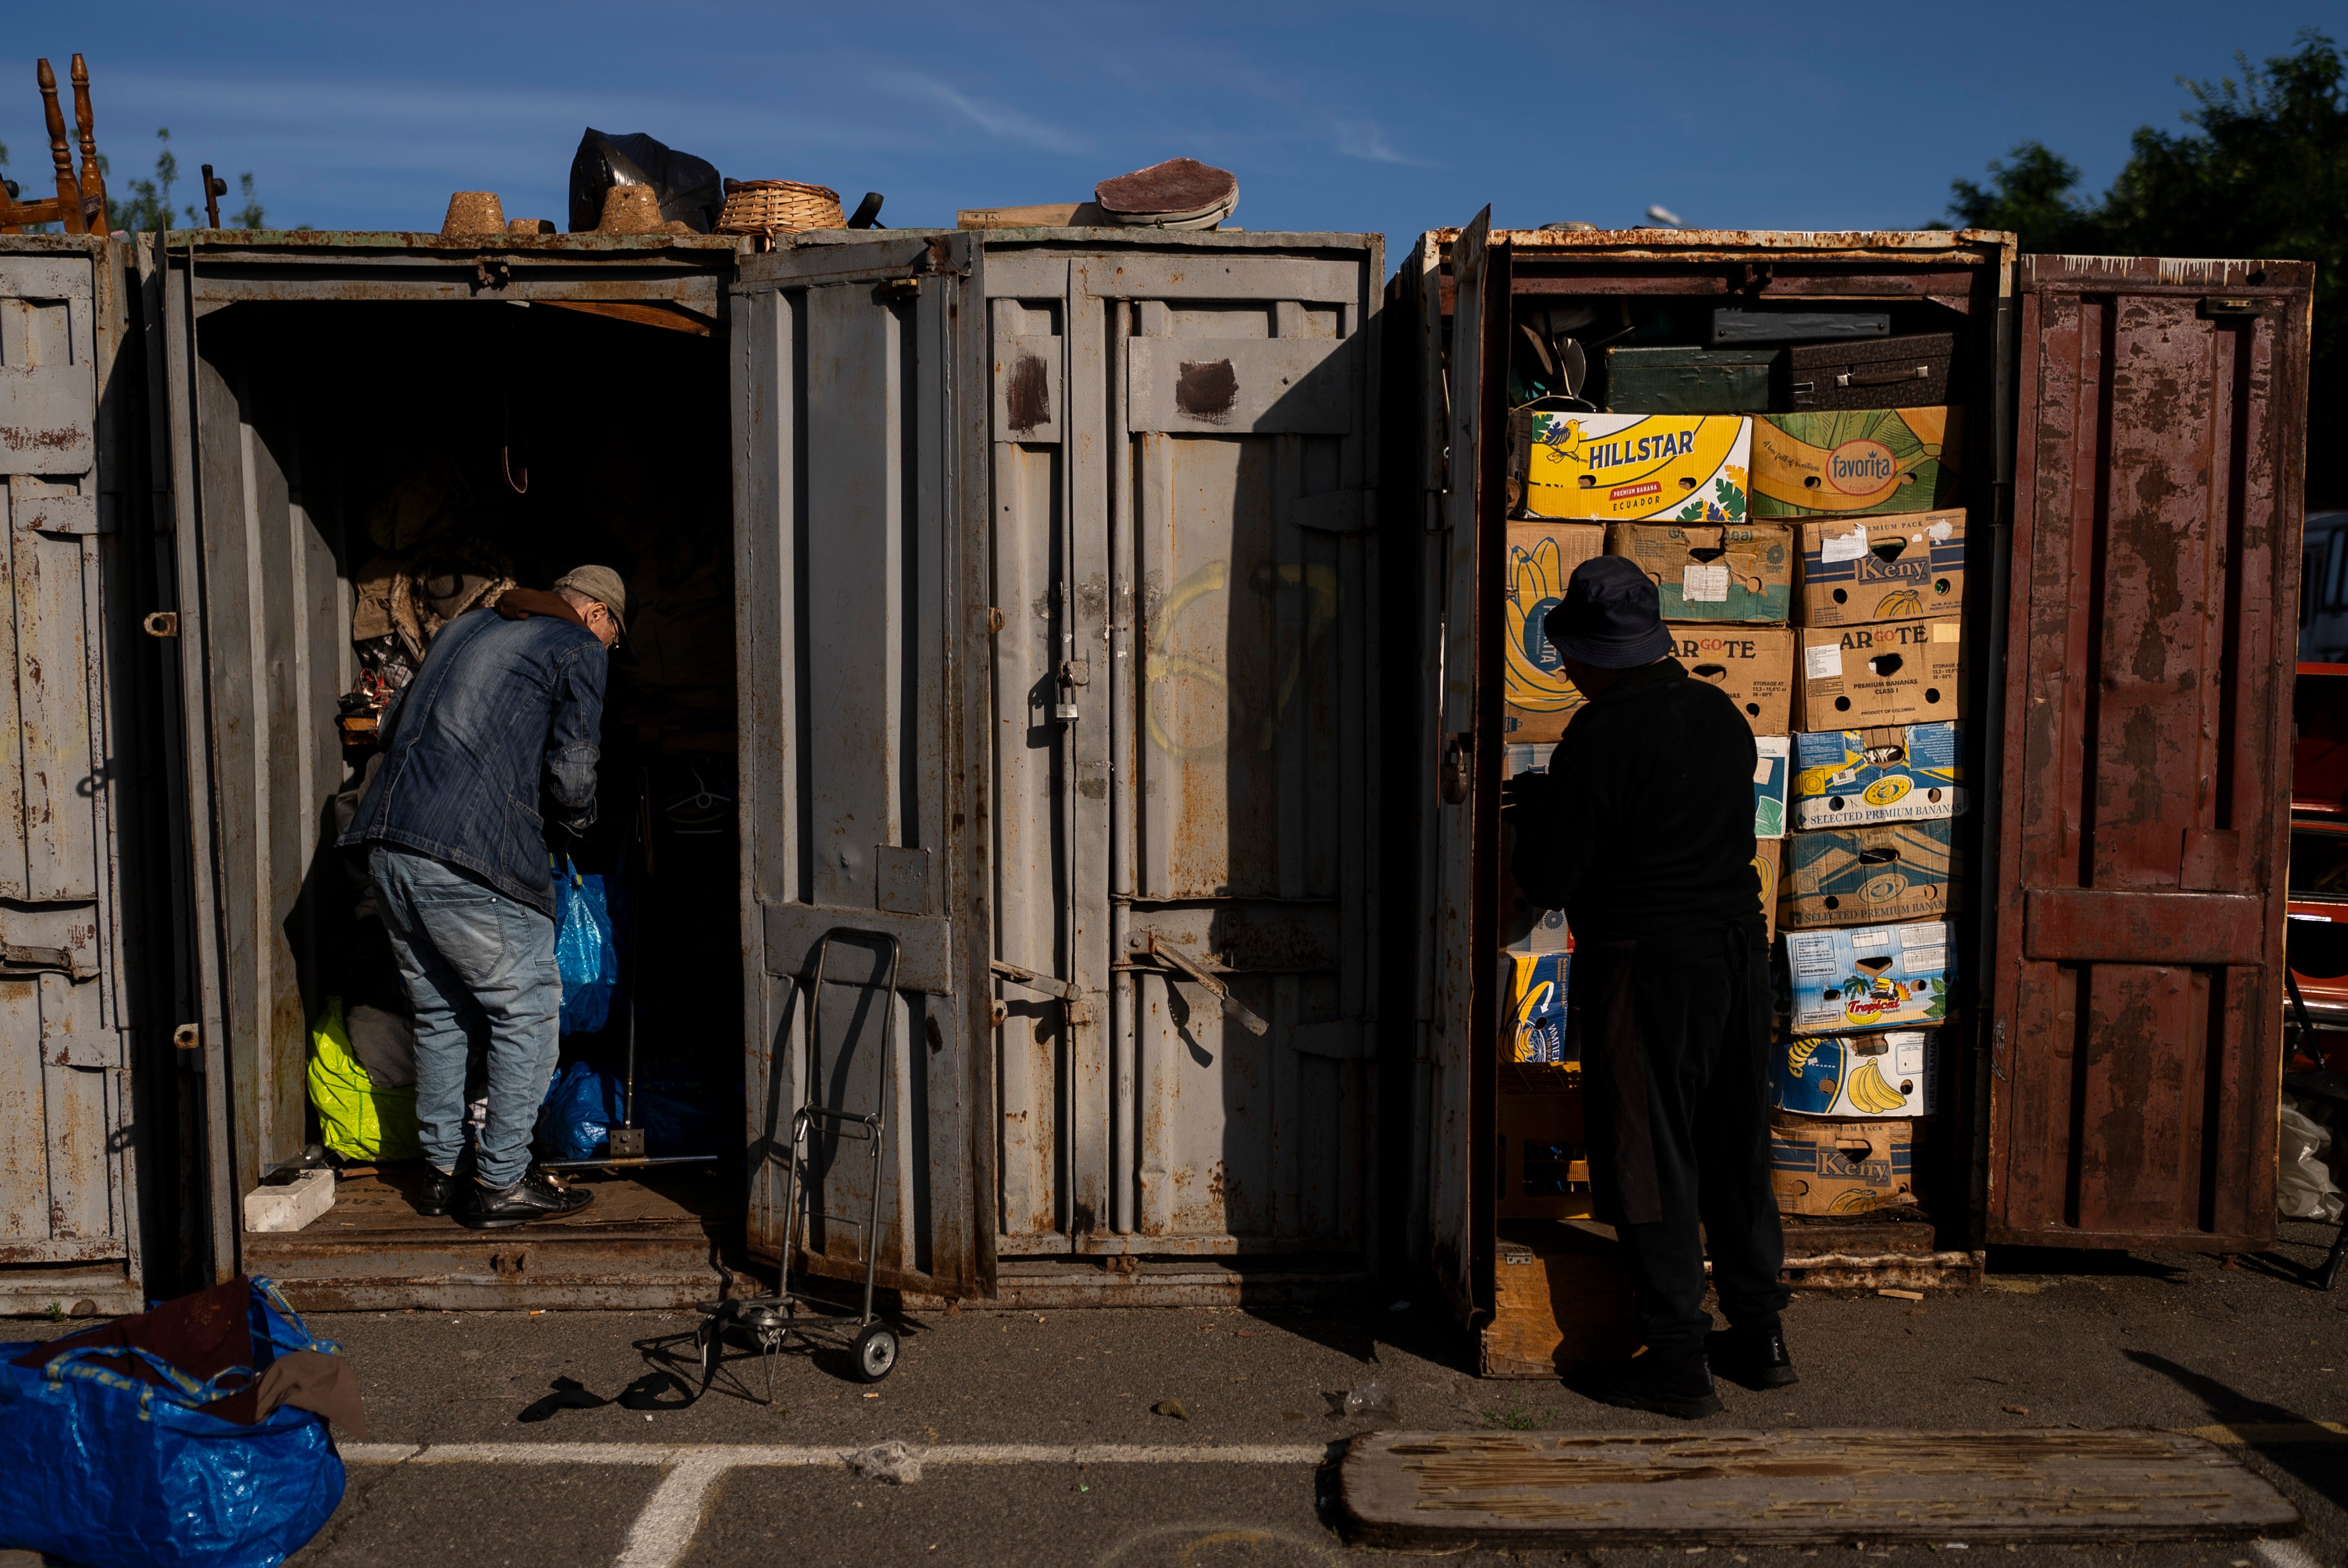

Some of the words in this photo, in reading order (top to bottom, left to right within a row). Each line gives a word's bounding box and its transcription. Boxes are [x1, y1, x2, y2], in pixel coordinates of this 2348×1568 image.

[1589, 431, 1693, 470] HILLSTAR
[1775, 453, 1788, 463] full
[1833, 455, 1890, 480] favorita
[1614, 488, 1635, 497] PREMIUM
[1637, 484, 1657, 493] BANANA
[1613, 496, 1660, 511] ECUADOR
[1859, 557, 1927, 581] Keny
[1840, 625, 1929, 650] ARGOTE
[1810, 813, 1863, 825] SELECTED
[1865, 806, 1912, 820] PREMIUM
[1916, 803, 1962, 815] BANANAS
[1805, 910, 1857, 923] SELECTED
[1860, 904, 1910, 919] PREMIUM
[1913, 899, 1959, 912] BANANAS
[1848, 997, 1900, 1014] Tropical
